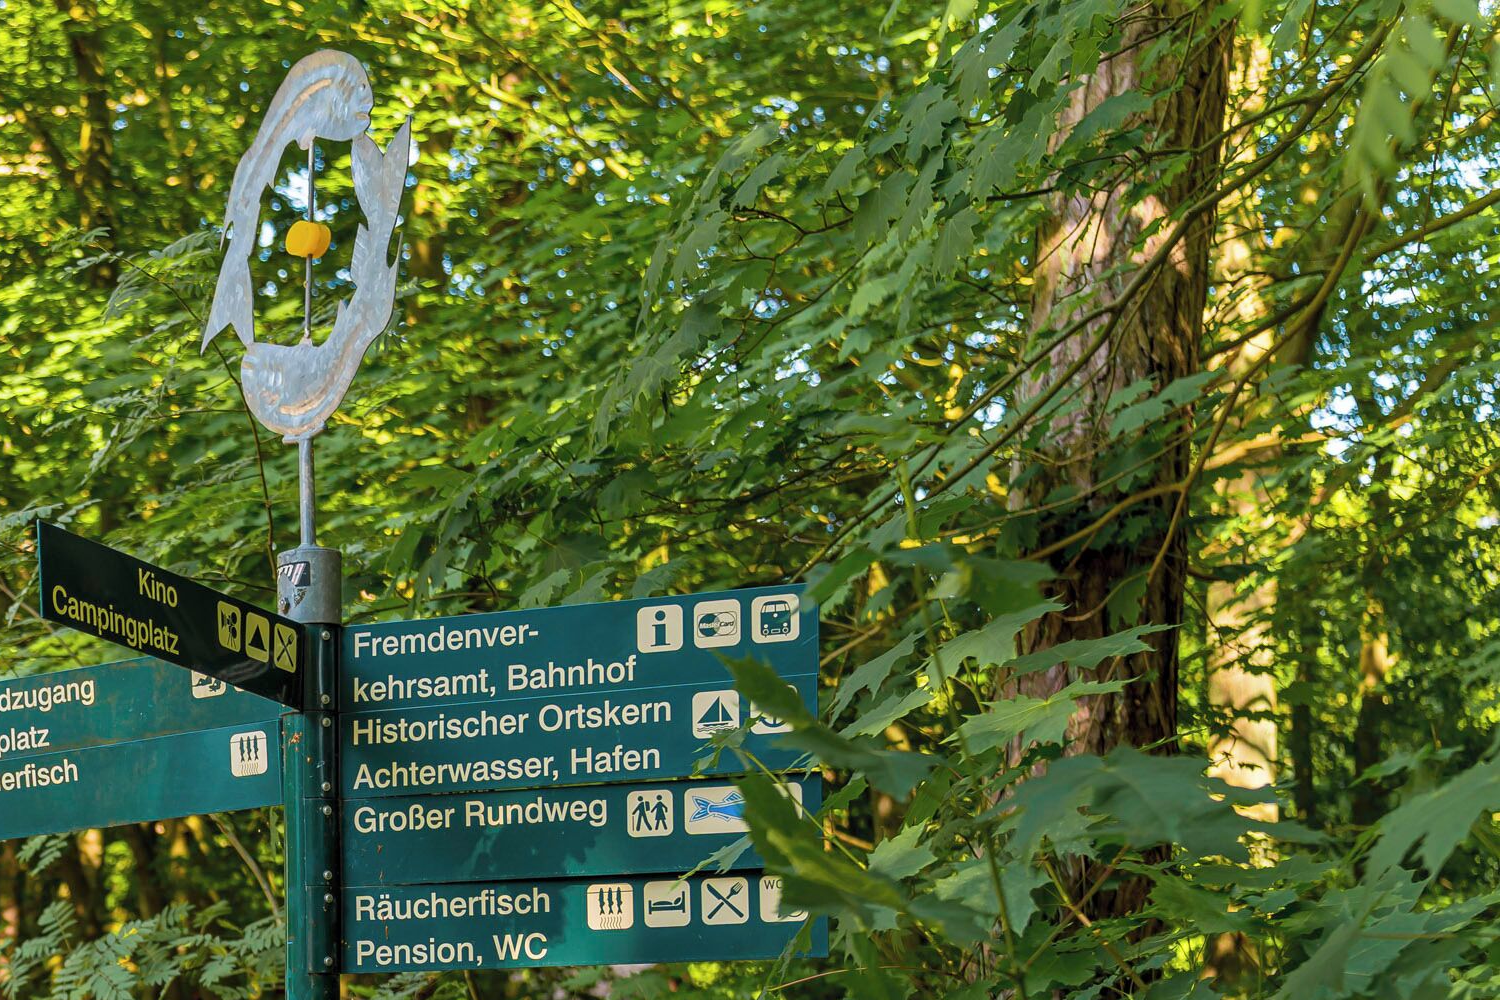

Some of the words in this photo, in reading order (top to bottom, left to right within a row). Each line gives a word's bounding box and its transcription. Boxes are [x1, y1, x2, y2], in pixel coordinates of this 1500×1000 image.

[138, 567, 178, 608] Kino
[52, 585, 180, 655] Campingplatz
[354, 623, 539, 658] Fremdenver-
[354, 668, 496, 702] kehrsamt,
[507, 655, 636, 692] Bahnhof
[353, 710, 529, 745] Historischer
[538, 699, 672, 732] Ortskern
[353, 756, 559, 790] Achterwasser,
[570, 744, 660, 774] Hafen
[353, 803, 455, 834] Großer
[465, 797, 607, 827] Rundweg
[355, 887, 550, 921] Räucherfisch
[356, 937, 483, 967] Pension,
[493, 932, 548, 960] WC
